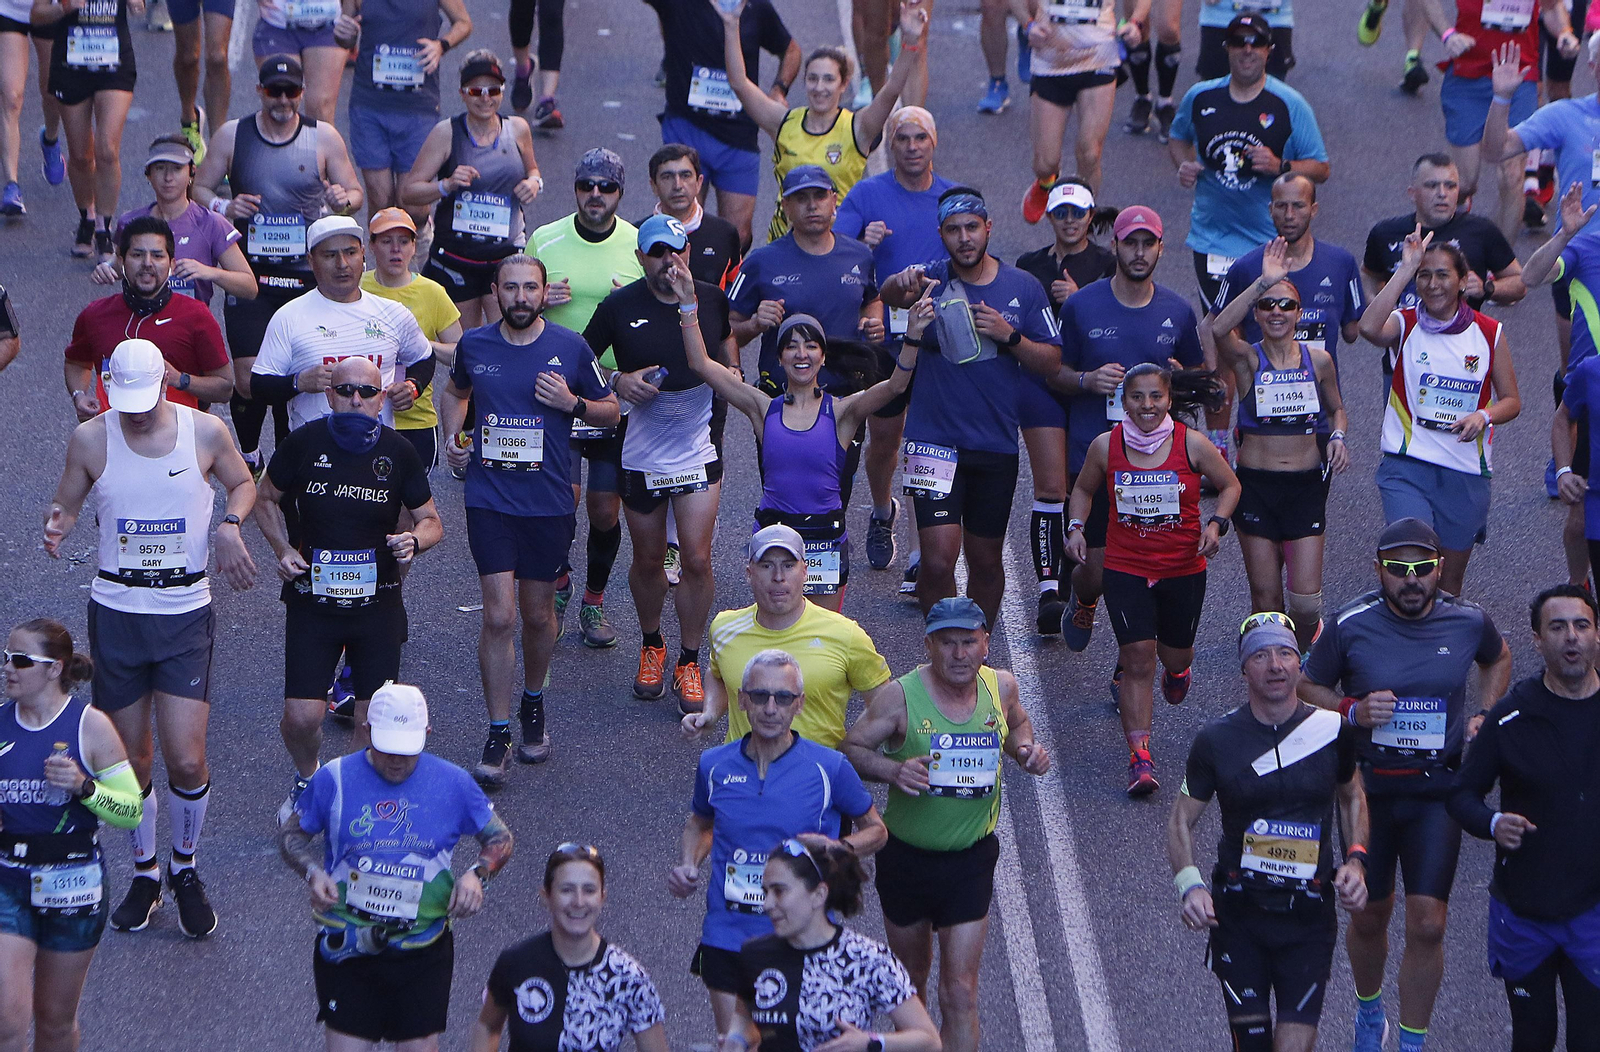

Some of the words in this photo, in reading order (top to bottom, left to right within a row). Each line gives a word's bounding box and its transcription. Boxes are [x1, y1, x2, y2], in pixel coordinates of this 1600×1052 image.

[473, 193, 505, 206] ZURICH
[469, 209, 495, 220] 13301
[265, 215, 299, 225] ZURICH
[468, 224, 491, 233] CÉLINE
[1440, 379, 1475, 391] ZURICH
[1274, 391, 1304, 402] 11494
[1271, 405, 1306, 414] ROSMARY
[1434, 411, 1457, 421] CINTIA
[499, 417, 536, 427] ZURICH
[496, 437, 527, 447] 10366
[501, 451, 519, 459] MAM
[916, 445, 952, 460] ZURICH
[914, 465, 935, 476] 8254
[652, 477, 675, 487] SEÑOR
[675, 473, 700, 485] GÓMEZ
[306, 481, 329, 496] LOS
[333, 484, 390, 503] JARTIBLES
[1132, 494, 1163, 504] 11495
[1134, 506, 1160, 515] NORMA
[139, 522, 178, 532] ZURICH
[139, 544, 166, 554] 9579
[333, 552, 370, 562] ZURICH
[141, 559, 163, 567] GARY
[329, 571, 361, 581] 11894
[325, 587, 364, 596] CRESPILLO
[1398, 701, 1438, 710] ZURICH
[393, 715, 408, 725] edp
[1392, 721, 1427, 731] 12163
[955, 736, 993, 746] ZURICH
[1396, 737, 1420, 747] VITTO
[951, 758, 984, 768] 11914
[956, 775, 975, 785] LUIS
[1270, 823, 1314, 838] ZURICH
[1267, 846, 1297, 861] 4978
[373, 862, 417, 879] ZURICH
[1260, 861, 1298, 875] PHILIPPE
[53, 875, 87, 890] 13116
[367, 885, 402, 900] 10376
[42, 897, 69, 905] JESUS
[70, 893, 95, 904] ANGEL
